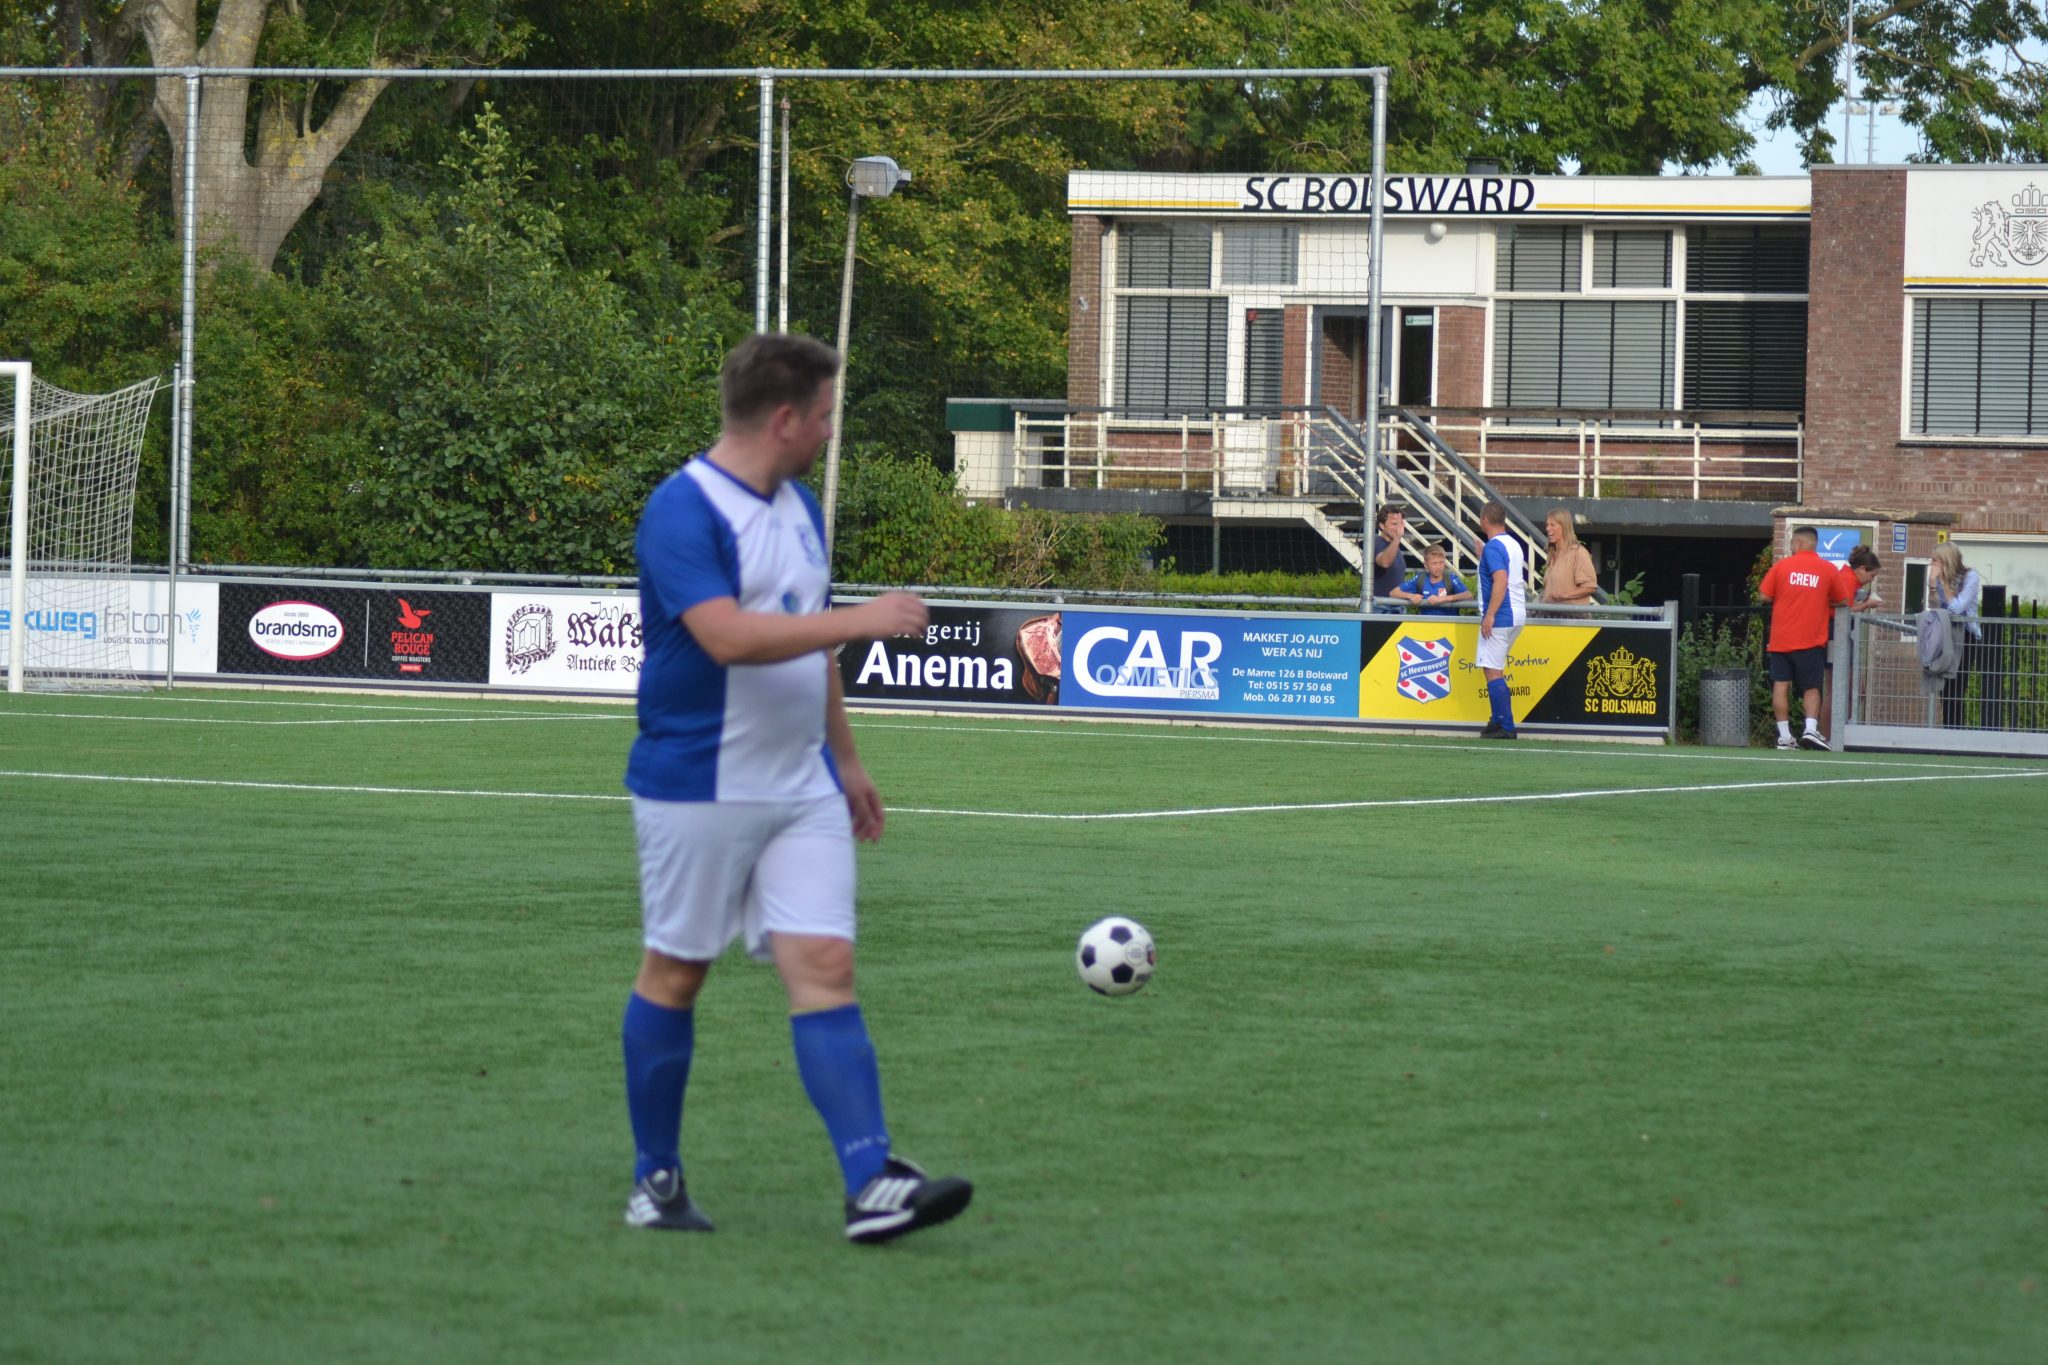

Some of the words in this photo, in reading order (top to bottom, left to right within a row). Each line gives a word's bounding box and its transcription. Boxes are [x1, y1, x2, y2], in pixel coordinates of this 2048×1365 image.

[1243, 177, 1290, 210] SC
[1301, 177, 1534, 212] BOLSWARD
[1789, 572, 1819, 588] CREW
[104, 605, 182, 634] fritom
[256, 619, 337, 638] brandsma
[391, 632, 433, 643] PELICAN
[1242, 632, 1288, 643] MAKKET
[1290, 634, 1305, 643] JO
[1307, 634, 1339, 644] AUTO
[394, 643, 430, 655] ROUGE
[1262, 647, 1287, 657] WER
[1288, 648, 1303, 658] AS
[1305, 648, 1322, 658] NIJ
[566, 654, 617, 671] Antieke
[856, 640, 1013, 690] Anema
[1073, 626, 1223, 699] CAR
[1408, 659, 1447, 675] Heerenveen
[1507, 654, 1550, 667] Partner
[1232, 667, 1245, 676] De
[1247, 668, 1276, 677] Marne
[1279, 669, 1296, 678] 126
[1297, 670, 1304, 678] B
[1306, 670, 1348, 680] Bolsward
[1248, 680, 1265, 689] Tel:
[1266, 681, 1290, 690] 0515
[1292, 682, 1304, 690] 57
[1306, 682, 1318, 691] 50
[1320, 683, 1332, 691] 68
[1179, 689, 1217, 699] PIERSMA
[1243, 692, 1265, 702] Mob.
[1268, 693, 1280, 702] 06
[1281, 694, 1294, 702] 28
[1296, 694, 1306, 703] 71
[1309, 695, 1321, 704] 80
[1323, 695, 1336, 704] 55
[1478, 688, 1489, 699] SC
[1508, 686, 1531, 697] WARD
[1584, 698, 1599, 712] SC
[1601, 698, 1657, 715] BOLSWARD
